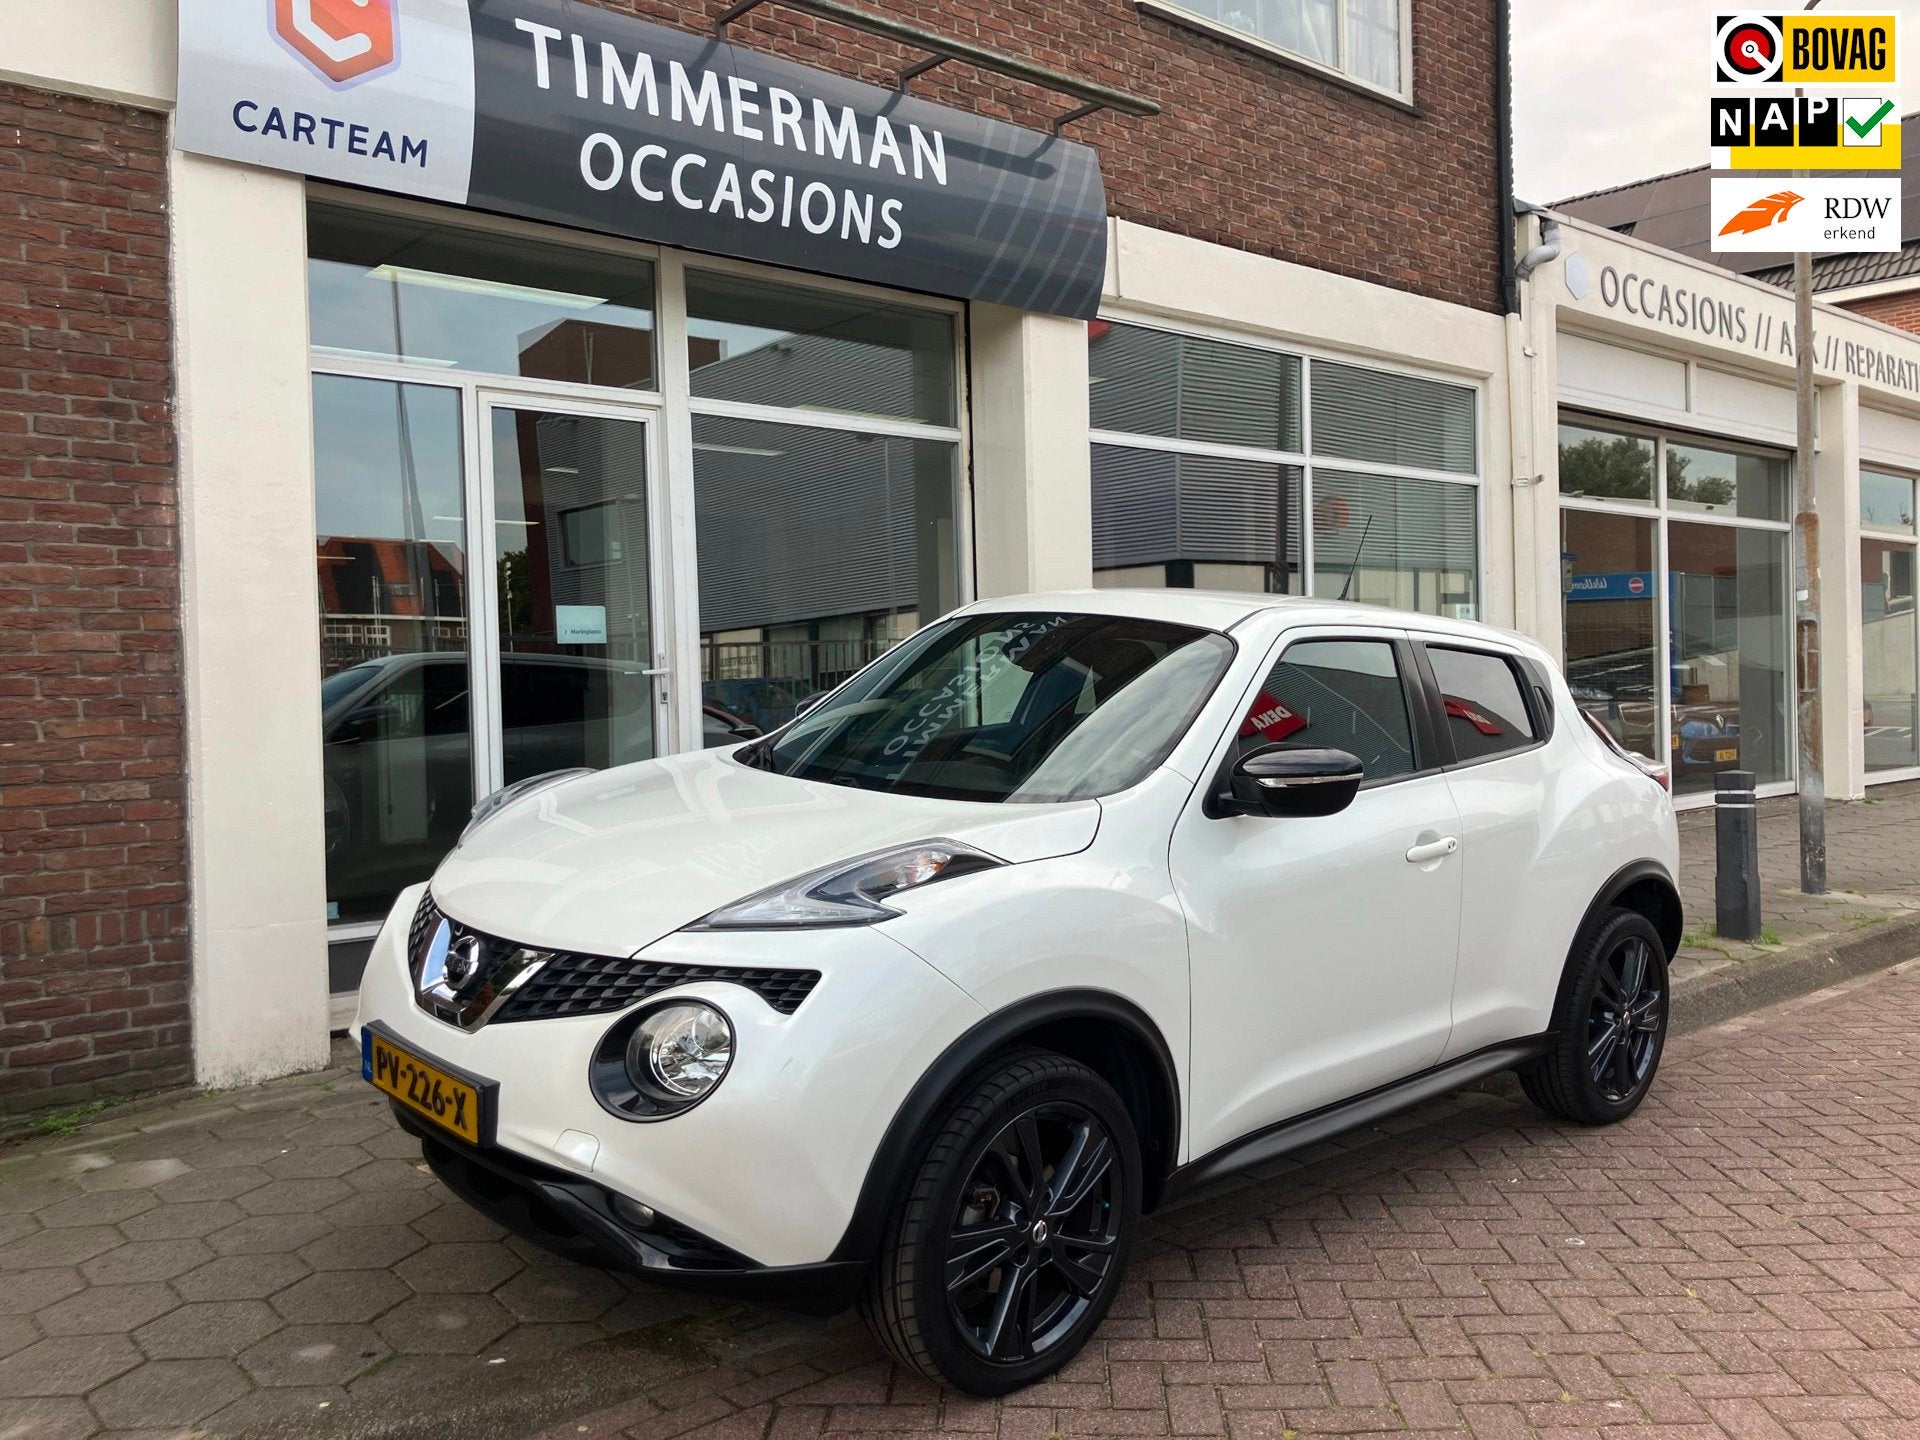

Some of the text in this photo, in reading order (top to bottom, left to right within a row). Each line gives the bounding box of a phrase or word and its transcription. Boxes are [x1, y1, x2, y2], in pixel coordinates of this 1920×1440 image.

[232, 100, 429, 168] CARTEAM
[515, 18, 948, 186] TIMMERMAN
[579, 132, 903, 250] OCCASIONS
[1600, 265, 1747, 344] OCCASIONS
[1845, 340, 1920, 394] REPARATI
[376, 1044, 468, 1132] PV-226-X
